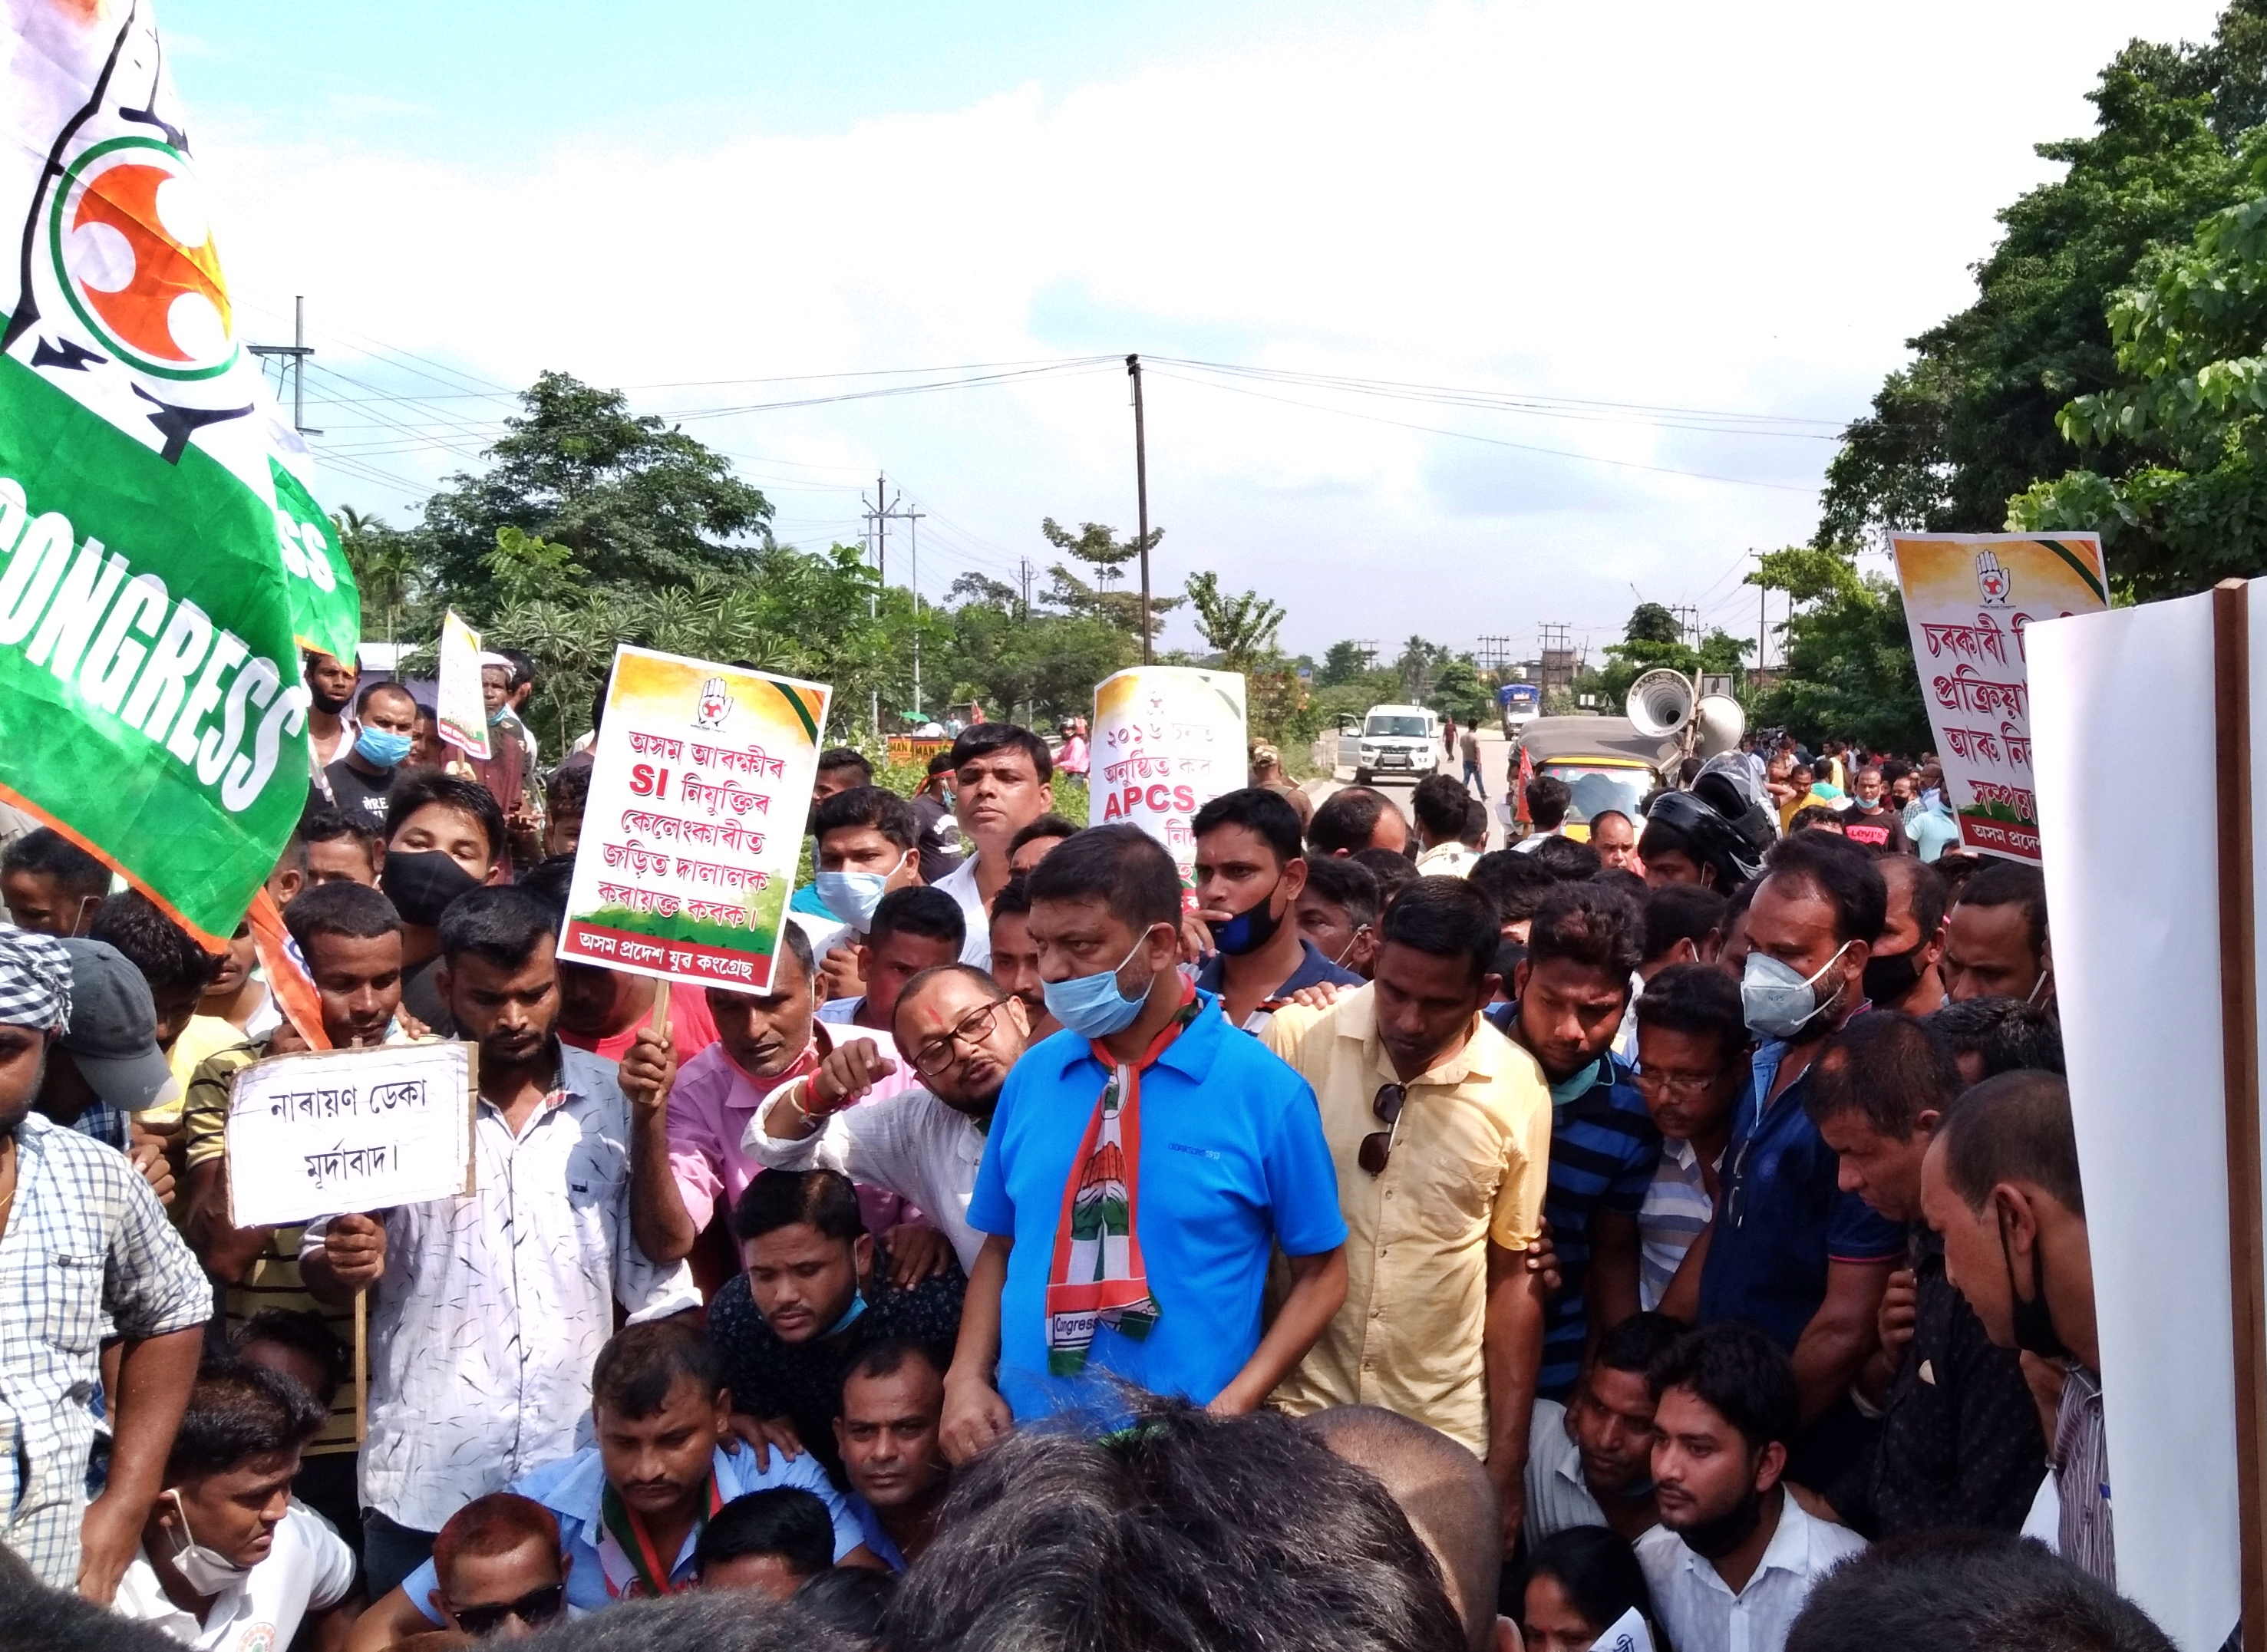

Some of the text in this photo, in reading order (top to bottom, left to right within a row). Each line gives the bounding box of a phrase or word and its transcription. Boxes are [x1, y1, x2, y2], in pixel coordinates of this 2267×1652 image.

[1920, 612, 2008, 668] চৰকাৰী
[629, 731, 786, 783] অসম আৰক্ষীৰ
[1942, 725, 2000, 767] আৰু
[629, 763, 771, 816] SI নিযুক্তিৰ
[1103, 783, 1196, 823] APCS
[622, 810, 766, 854] কেলেংকাৰীত
[1971, 824, 2006, 844] অসম
[602, 839, 770, 893] জড়িত দালালক
[579, 932, 617, 955] অসম
[619, 941, 665, 964] প্ৰদেশ
[369, 1077, 427, 1114] ডেকা
